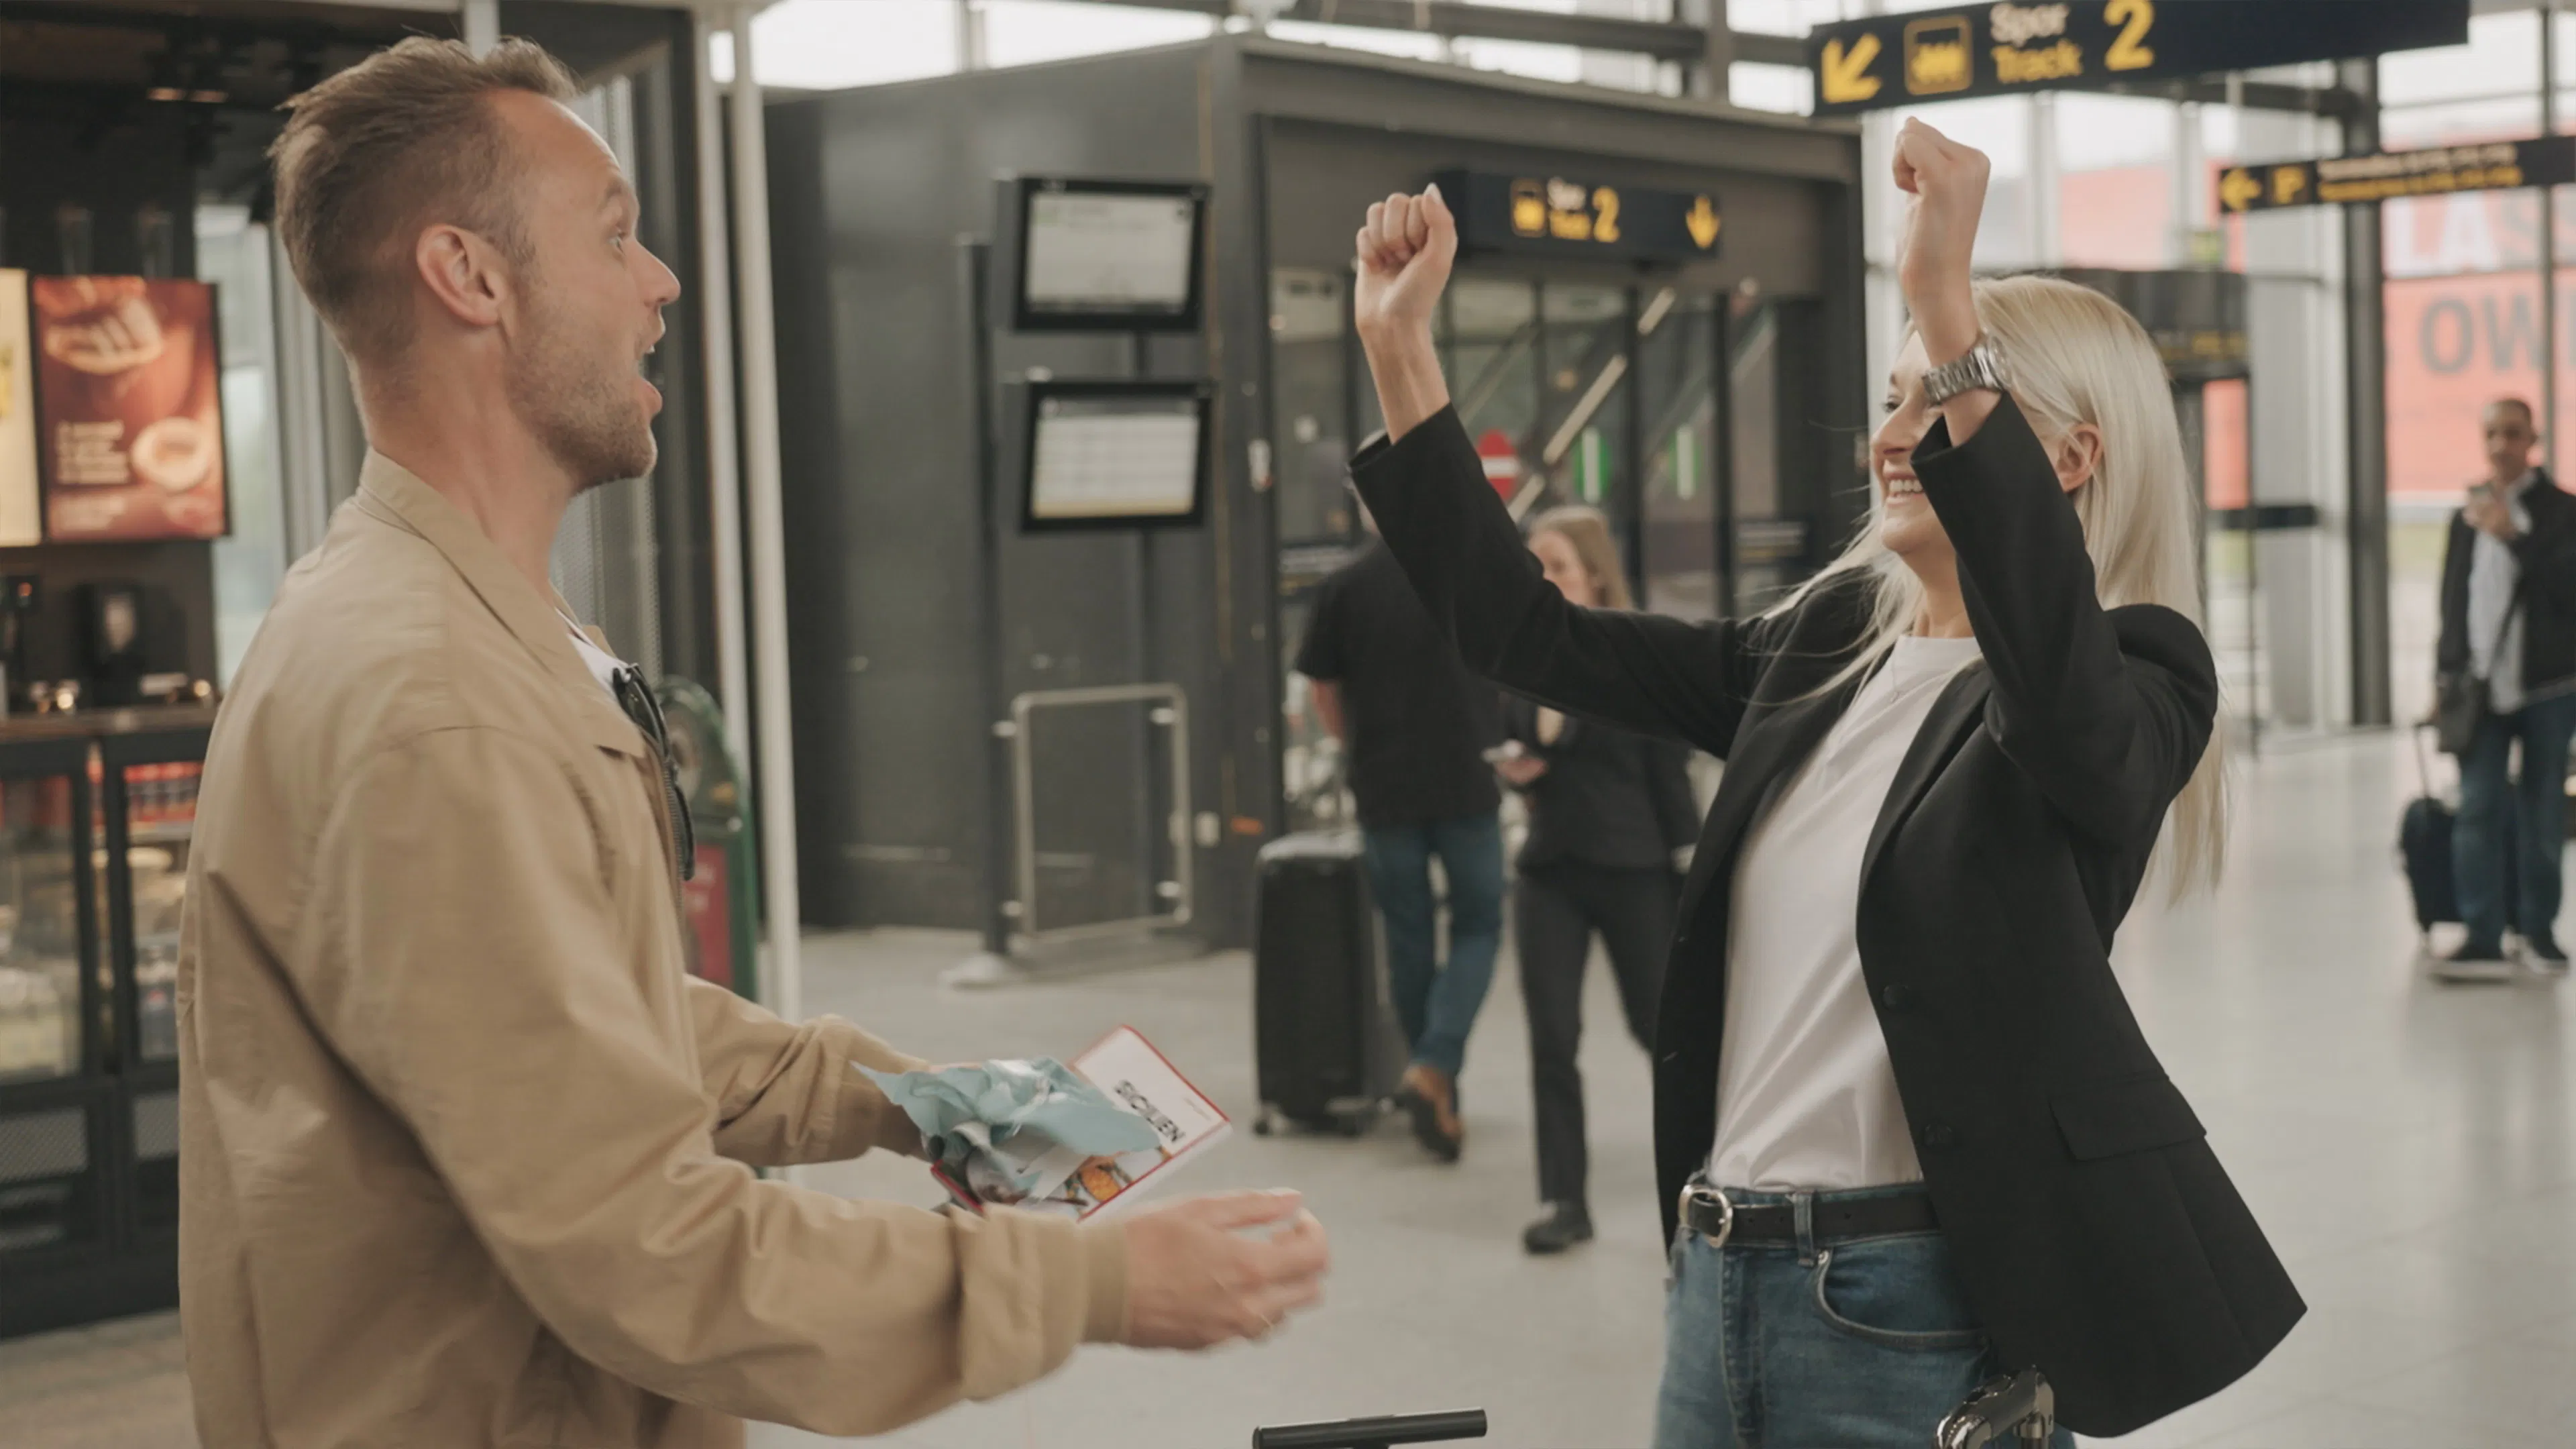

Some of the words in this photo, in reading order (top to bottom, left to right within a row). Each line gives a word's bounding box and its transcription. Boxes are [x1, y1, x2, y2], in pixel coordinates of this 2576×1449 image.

[1990, 3, 2068, 46] Spor
[2104, 0, 2154, 71] 2
[1592, 185, 1620, 243] 2
